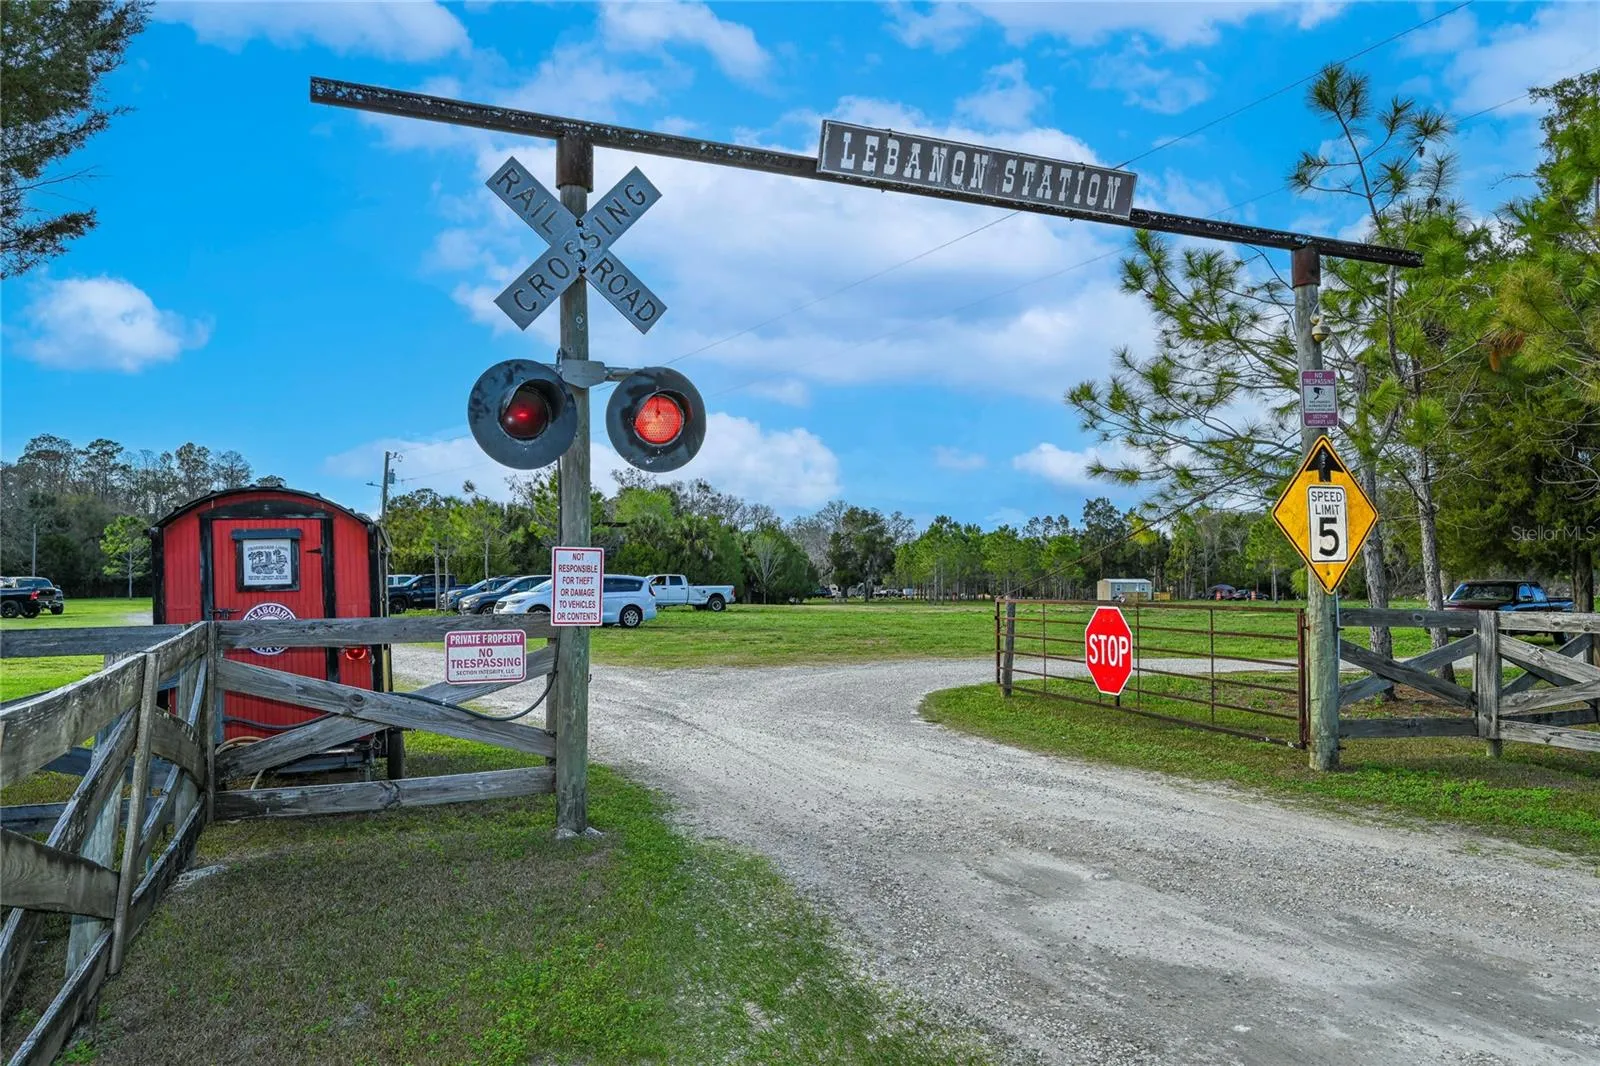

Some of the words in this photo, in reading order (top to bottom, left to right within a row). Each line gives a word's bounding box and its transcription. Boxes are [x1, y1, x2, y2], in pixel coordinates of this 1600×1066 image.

[840, 132, 989, 189] LEBANON
[1002, 158, 1122, 211] STATION
[496, 167, 558, 236] RAIL
[591, 257, 657, 322] ROAD
[513, 184, 646, 313] CROSSING
[1311, 491, 1343, 502] SPEED
[1315, 504, 1340, 515] LIMIT
[1319, 517, 1340, 557] 5
[572, 553, 585, 561] NOT
[558, 564, 598, 573] RESPONSIBLE
[562, 576, 574, 585] FOR
[576, 576, 594, 585] THEFT
[560, 588, 570, 597] OR
[570, 588, 595, 597] DAMAGE
[559, 600, 566, 609] TO
[568, 600, 596, 609] VEHICLES
[557, 612, 565, 621] OR
[567, 612, 598, 621] CONTENTS
[450, 634, 481, 645] PRIVATE
[482, 633, 521, 644] PROPERTY
[478, 648, 494, 658] NO
[1089, 633, 1129, 668] STOP
[451, 657, 521, 669] TRESPASSING
